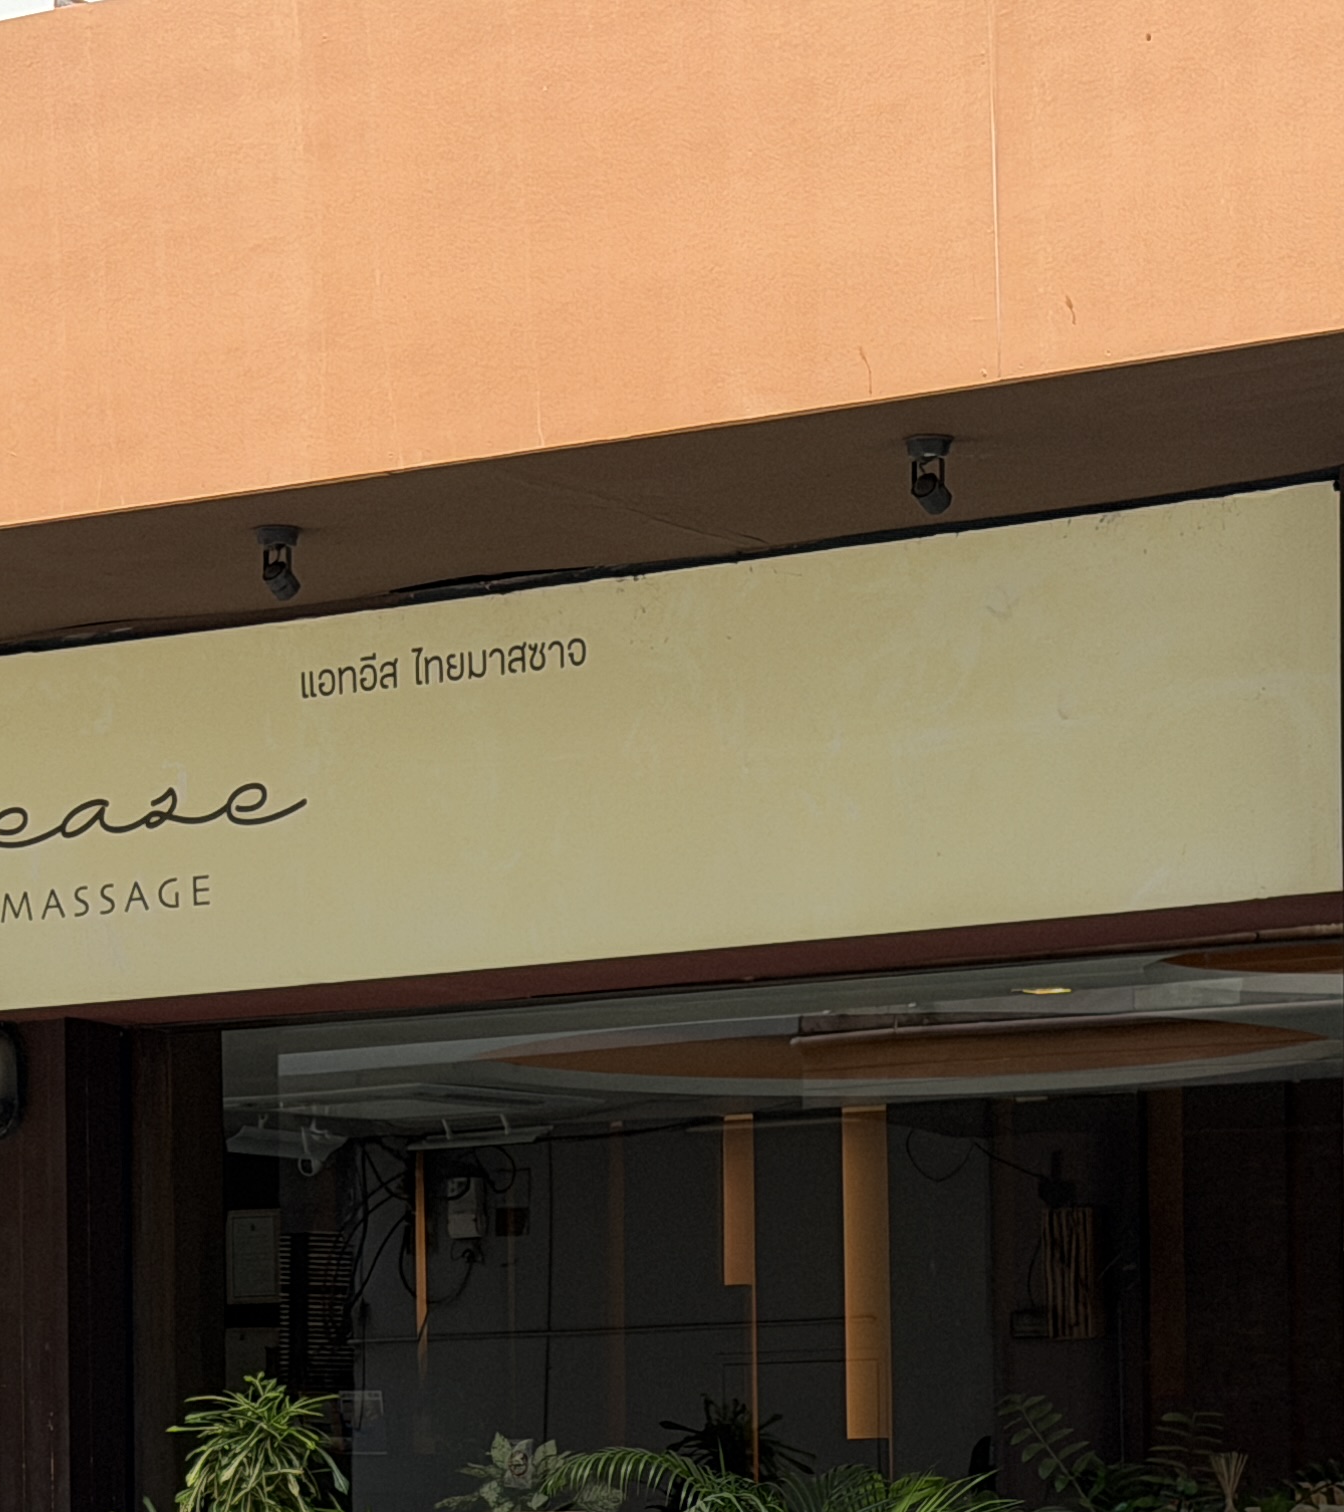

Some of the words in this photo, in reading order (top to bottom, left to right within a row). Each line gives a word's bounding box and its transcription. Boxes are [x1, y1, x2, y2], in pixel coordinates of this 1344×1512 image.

[301, 653, 399, 699] แอทอีส
[411, 637, 587, 685] ไทยมาสซาจ
[0, 874, 213, 924] MASSAGE
